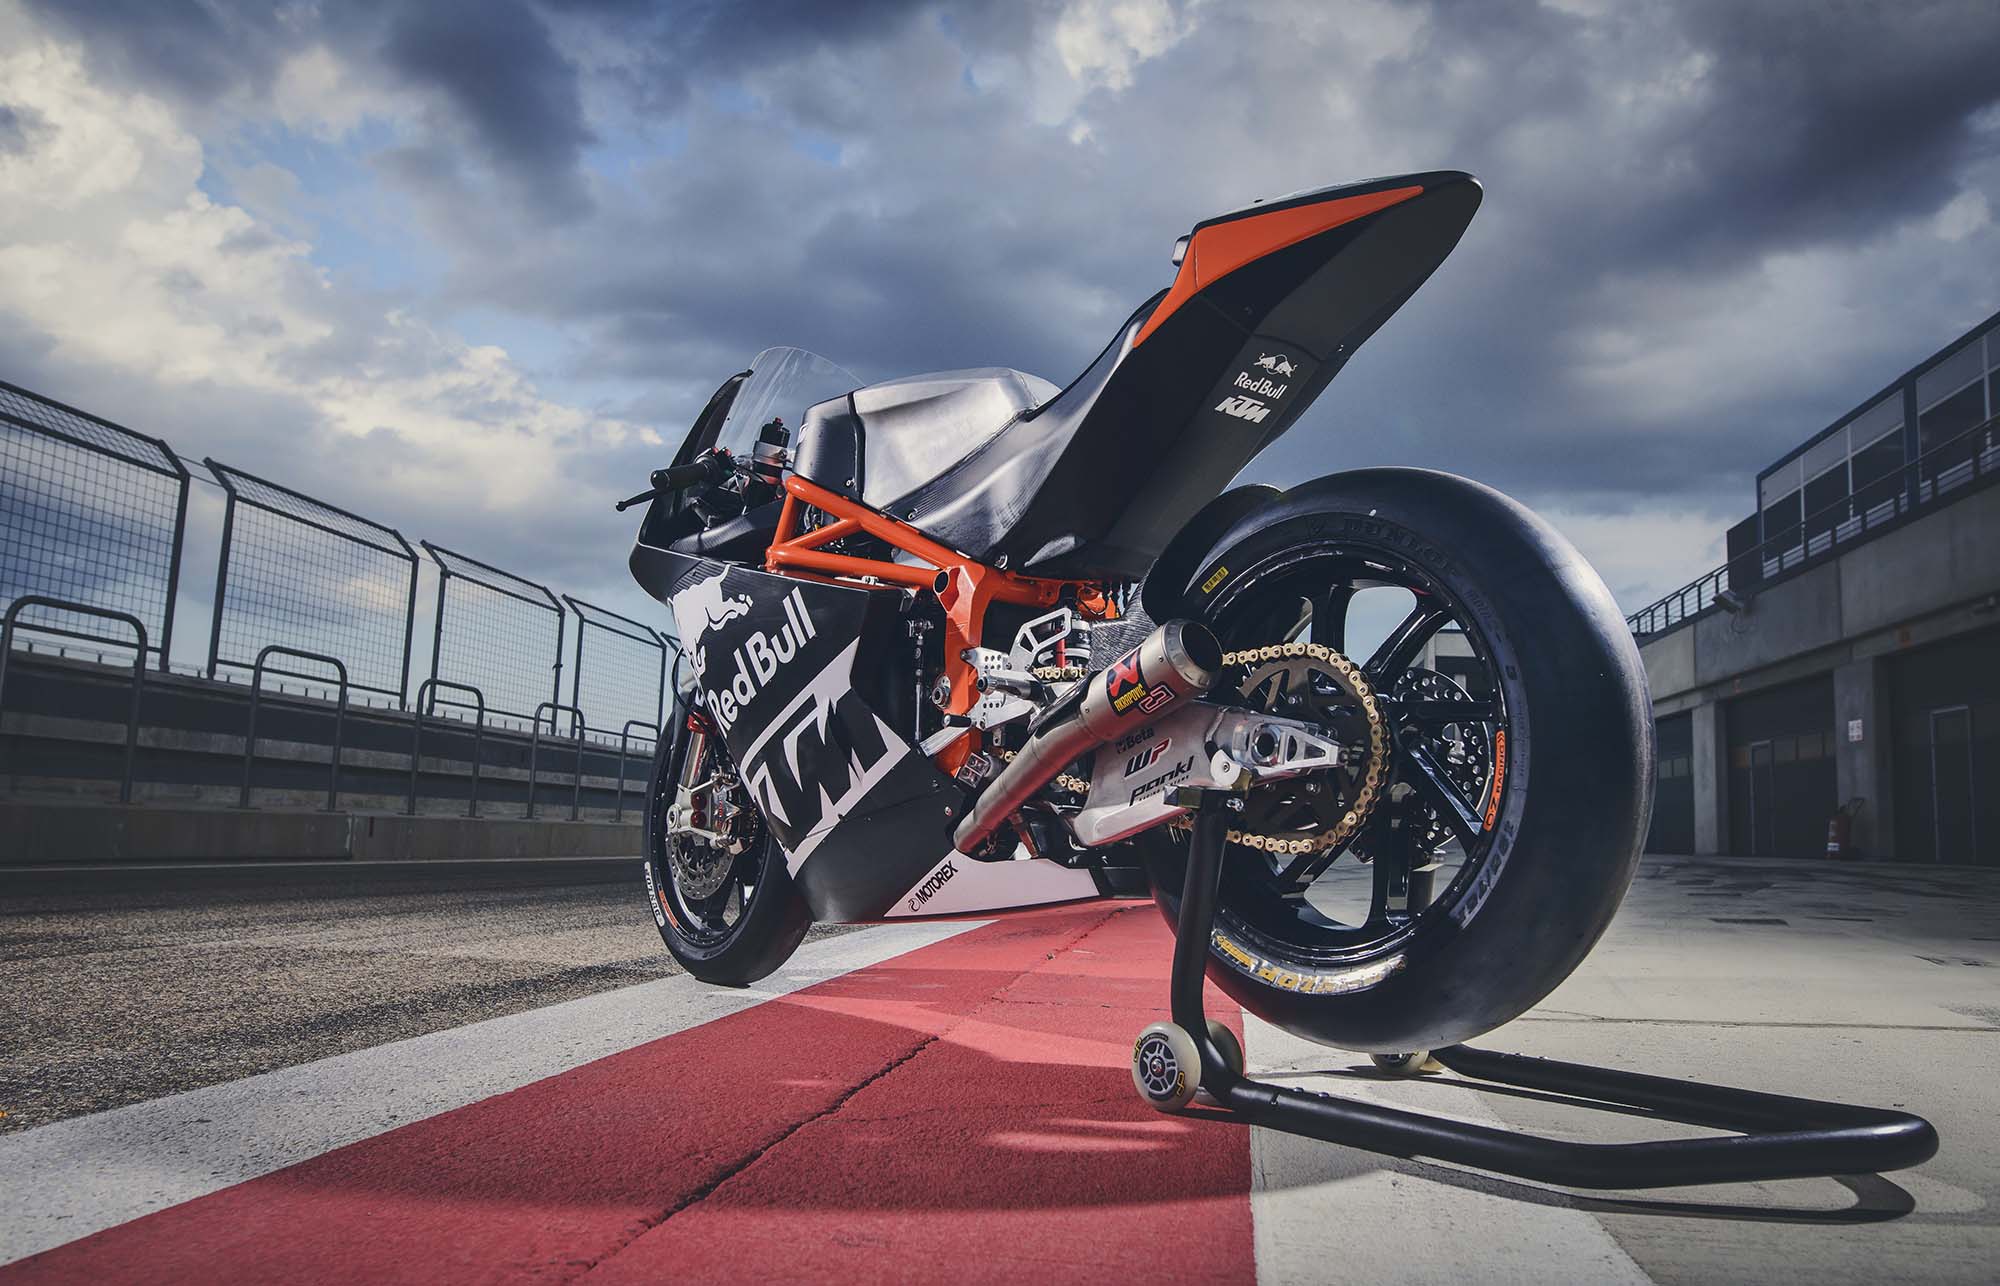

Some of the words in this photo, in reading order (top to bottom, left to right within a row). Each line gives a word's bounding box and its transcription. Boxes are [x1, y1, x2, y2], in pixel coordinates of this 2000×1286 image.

[1214, 395, 1271, 424] KTM
[738, 637, 911, 878] KTM
[1124, 738, 1171, 778] WP
[915, 860, 959, 905] MOTOREX
